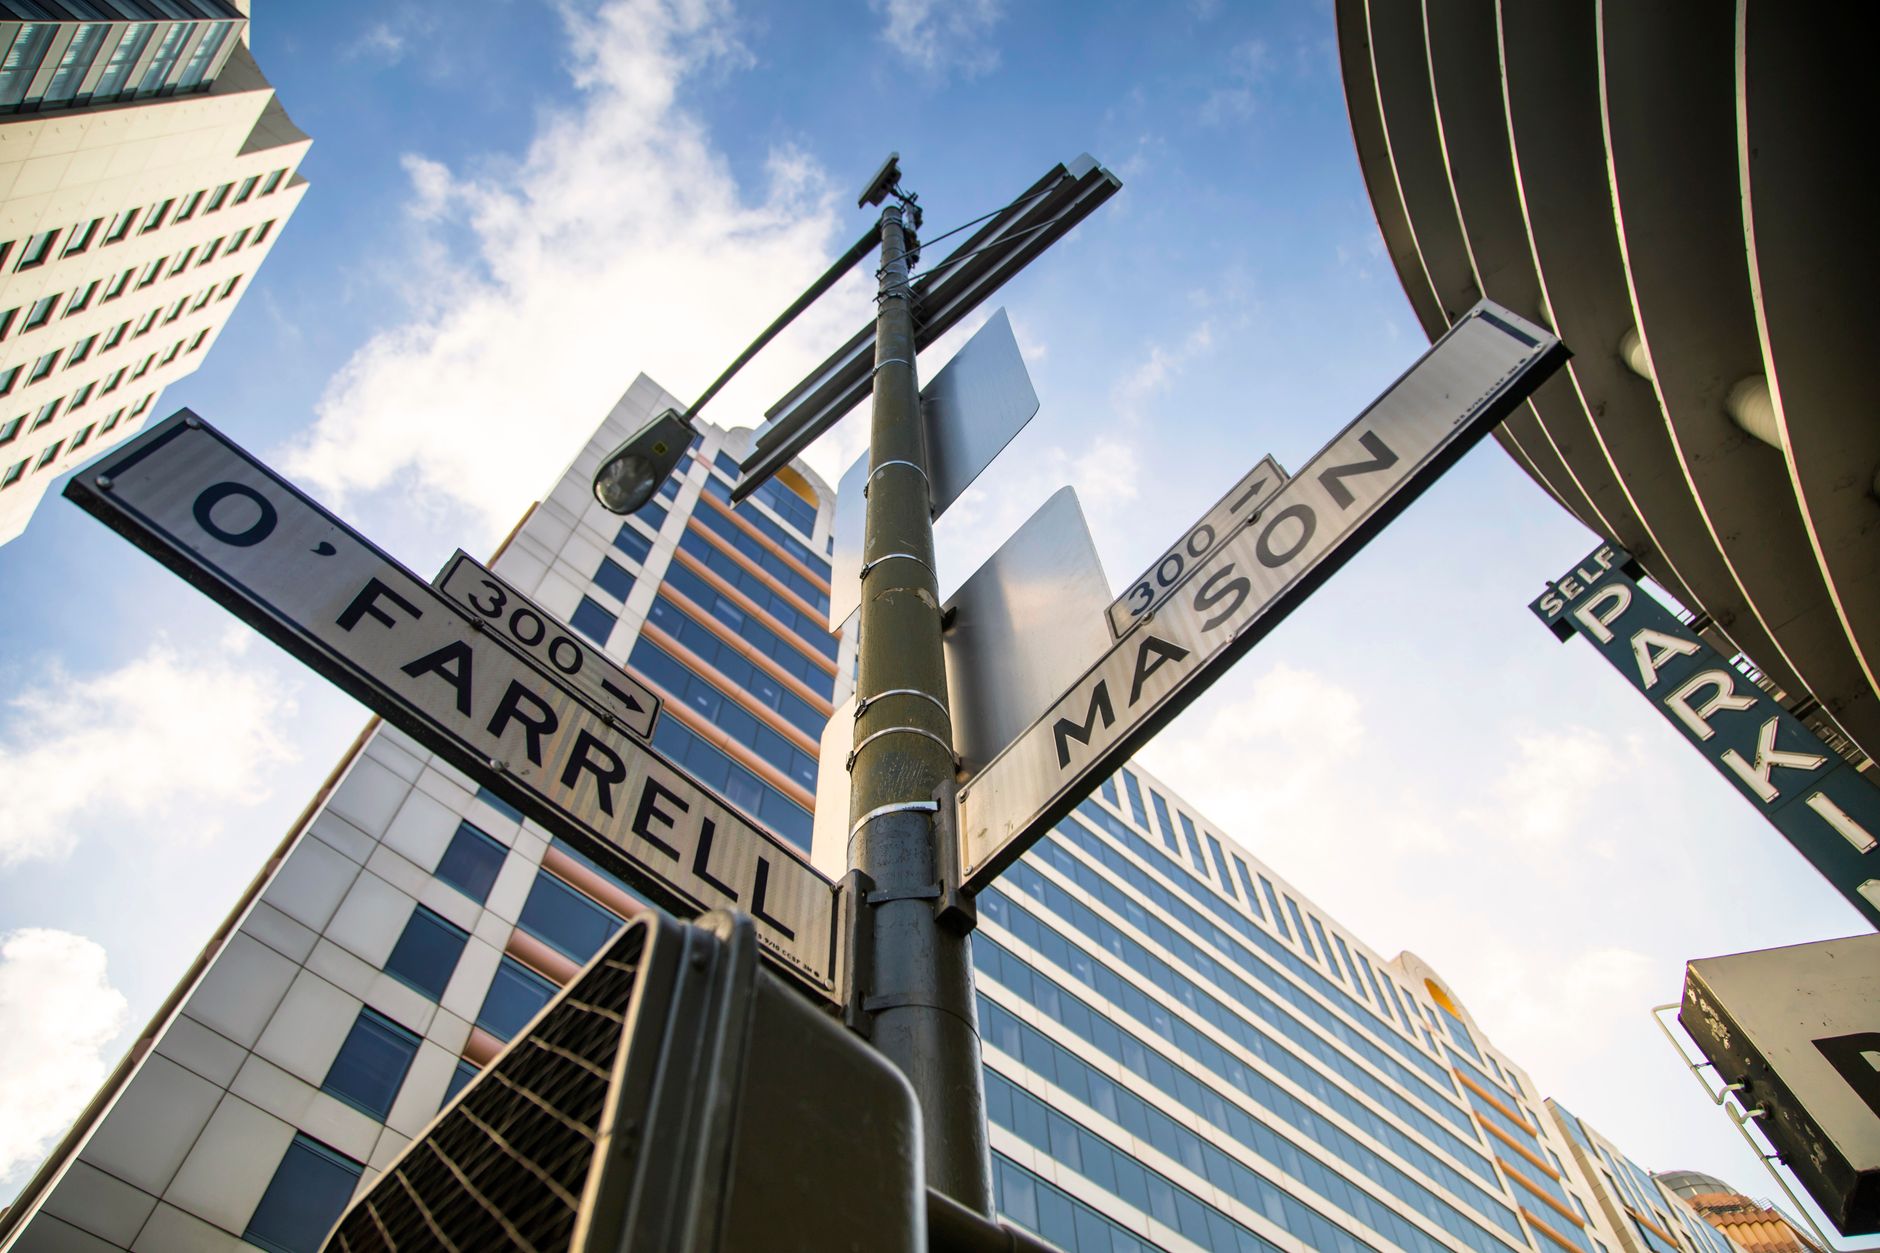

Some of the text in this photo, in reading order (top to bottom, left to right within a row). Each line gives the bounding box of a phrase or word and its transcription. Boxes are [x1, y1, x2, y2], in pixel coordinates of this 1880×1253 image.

[1053, 430, 1399, 770] MASON
[1129, 524, 1216, 617] 300
[1539, 546, 1615, 618] SELF
[467, 579, 584, 675] 300
[193, 481, 795, 942] O'FARRELL
